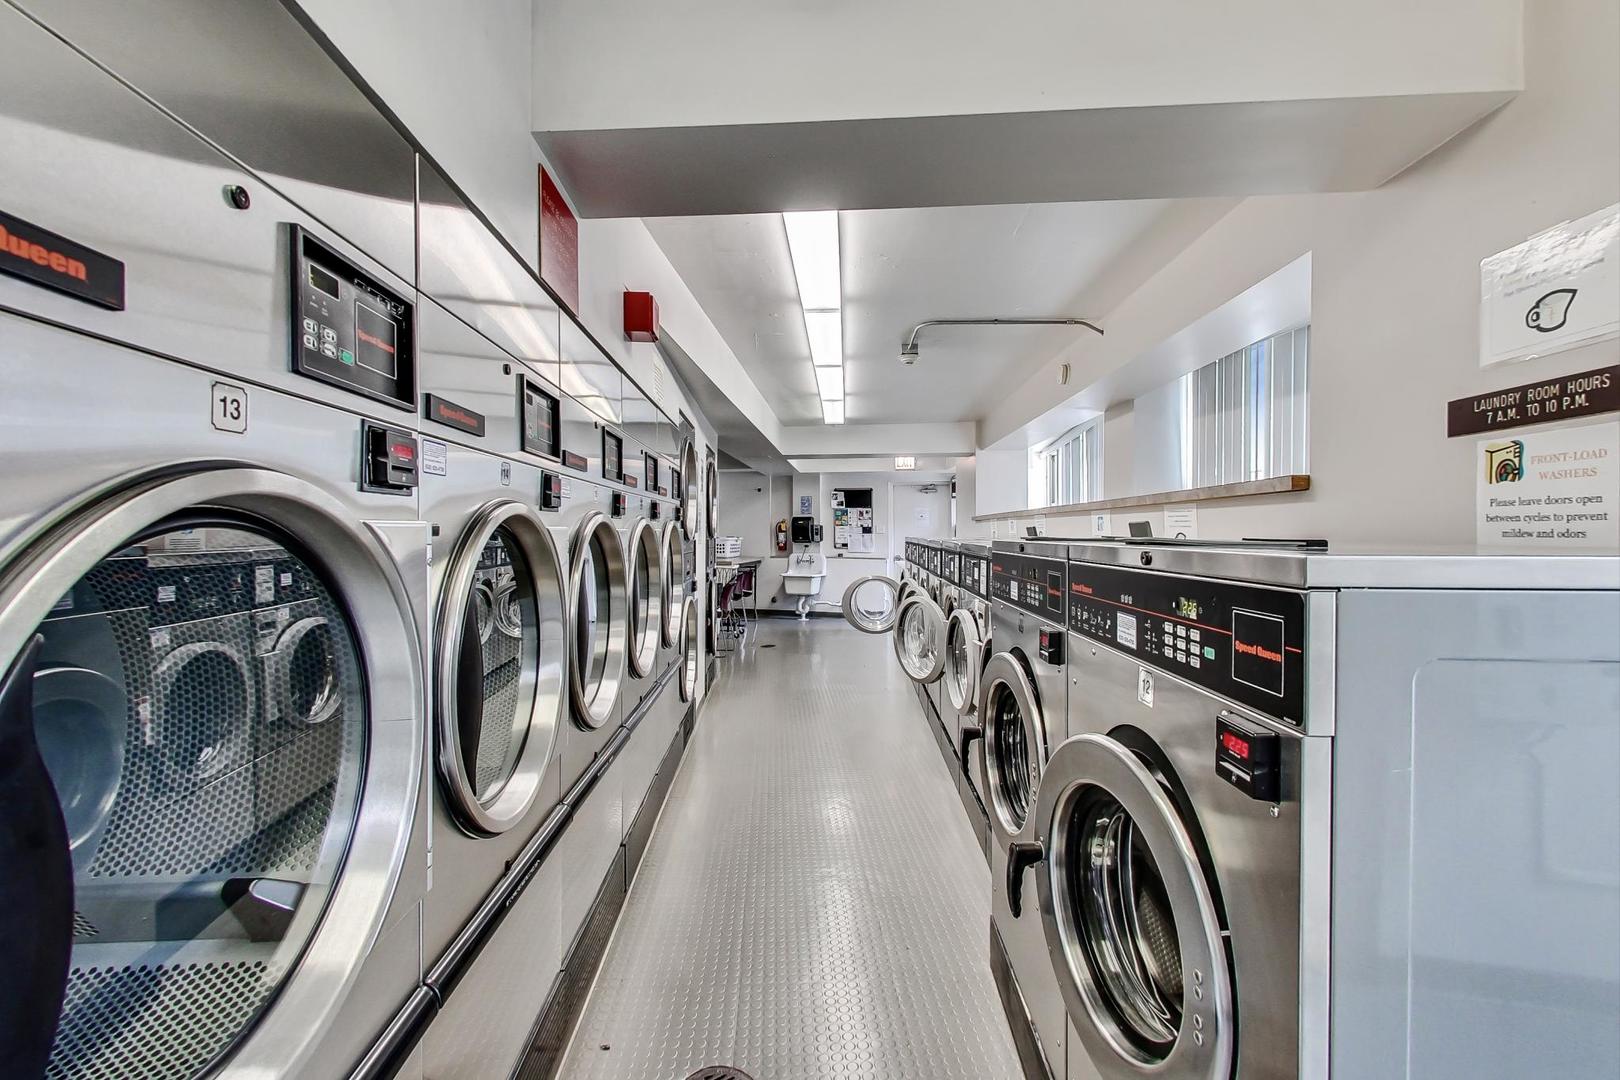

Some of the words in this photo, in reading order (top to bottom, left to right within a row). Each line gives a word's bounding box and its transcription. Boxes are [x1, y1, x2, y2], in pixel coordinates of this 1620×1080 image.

[1473, 391, 1522, 413] LAUNDRY
[1527, 383, 1560, 403] ROOM
[1567, 373, 1611, 394] HOURS
[219, 396, 241, 420] 13
[1486, 412, 1493, 424] 7
[1496, 407, 1521, 423] A.M.
[1526, 402, 1540, 417] TO
[1546, 399, 1558, 413] 10
[1562, 393, 1589, 411] P.M.
[1530, 448, 1608, 465] FRONT-LOAD
[1538, 467, 1599, 480] WASHERS
[1489, 498, 1516, 507] Please
[1518, 497, 1542, 505] leave
[1544, 495, 1574, 505] doors
[1575, 495, 1603, 506] open
[1486, 513, 1521, 522] between
[1523, 512, 1551, 524] cycles
[1553, 513, 1564, 521] to
[1566, 512, 1608, 523] prevent
[1502, 528, 1534, 538] mildew
[1536, 528, 1555, 538] and
[1556, 528, 1587, 538] odors
[1235, 640, 1257, 655] Speed
[1257, 646, 1281, 662] Queen
[1142, 679, 1151, 695] 12
